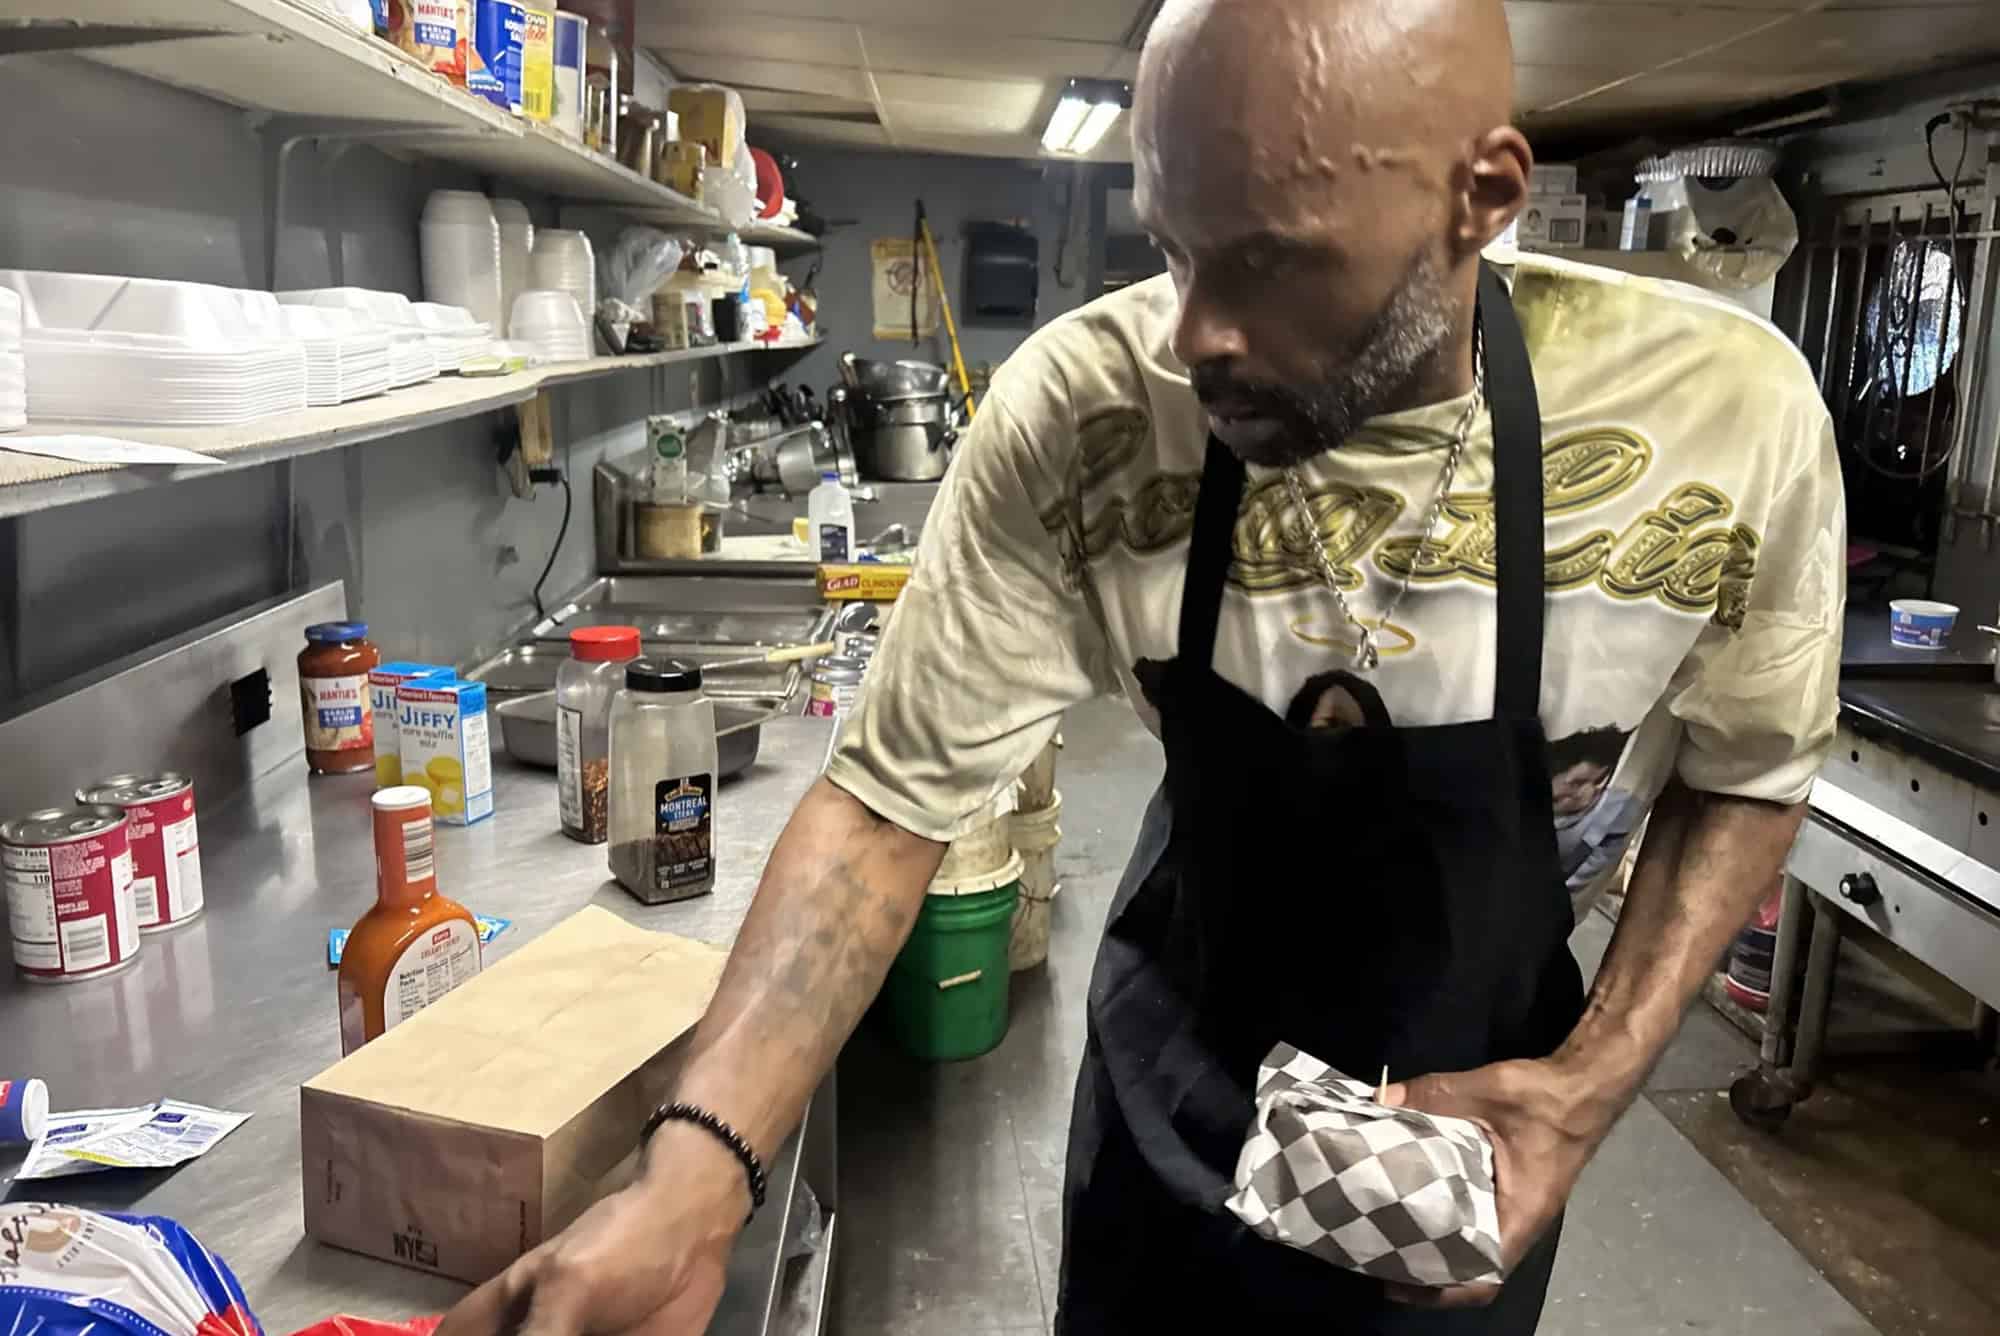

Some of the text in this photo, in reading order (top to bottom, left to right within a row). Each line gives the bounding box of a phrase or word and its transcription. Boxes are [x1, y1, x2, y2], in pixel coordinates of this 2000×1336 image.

[827, 576, 858, 591] GLAD
[401, 707, 454, 728] JIFFY
[660, 796, 707, 815] MONTREAL
